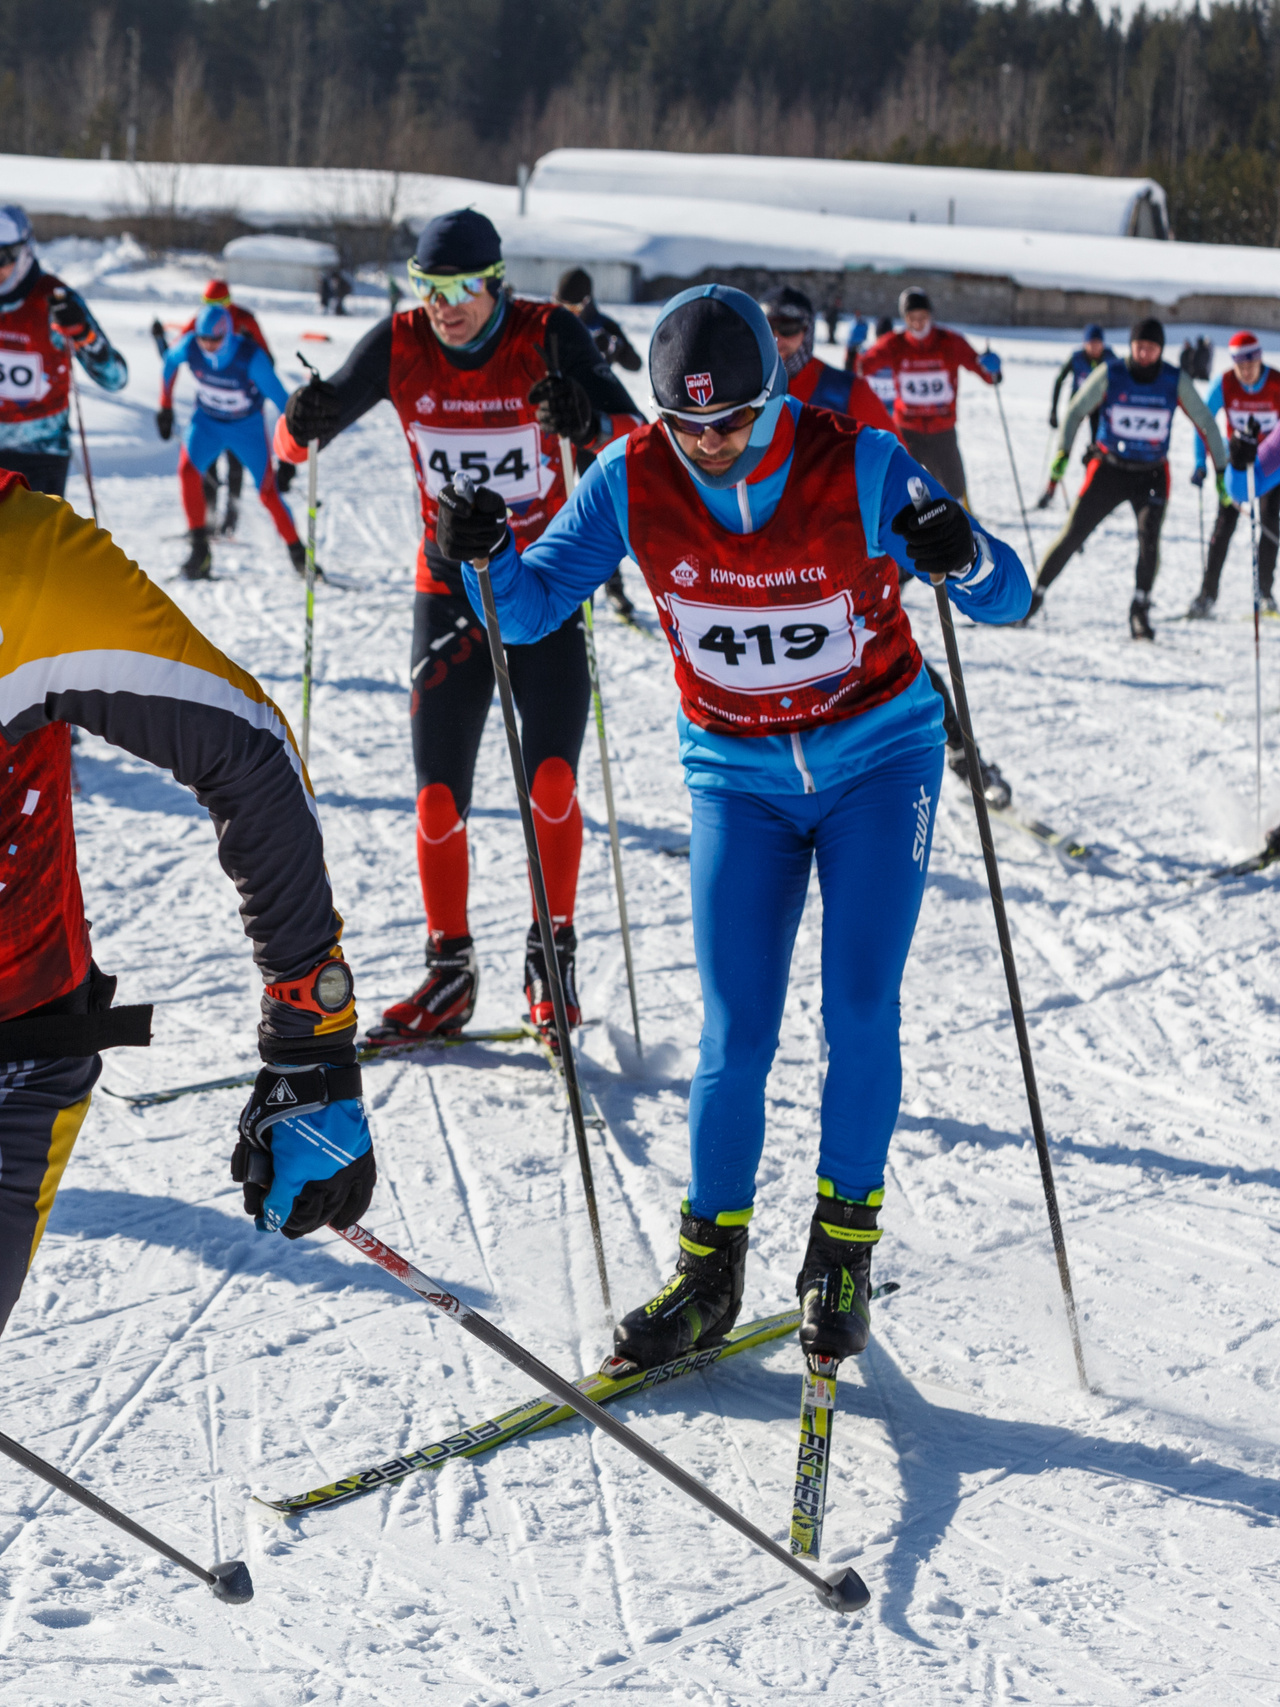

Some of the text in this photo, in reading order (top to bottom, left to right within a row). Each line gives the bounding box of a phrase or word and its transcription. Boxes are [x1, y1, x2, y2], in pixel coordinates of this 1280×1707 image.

[428, 447, 530, 485] 454
[917, 503, 948, 526] MADSHUS
[675, 569, 694, 579] КССК
[710, 567, 797, 589] КИРОВСКИЙ
[800, 566, 827, 583] ССК
[698, 623, 830, 666] 419
[640, 1349, 723, 1391] FISCHER
[358, 1419, 503, 1485] FISCHER
[792, 1429, 827, 1520] FISCHER
